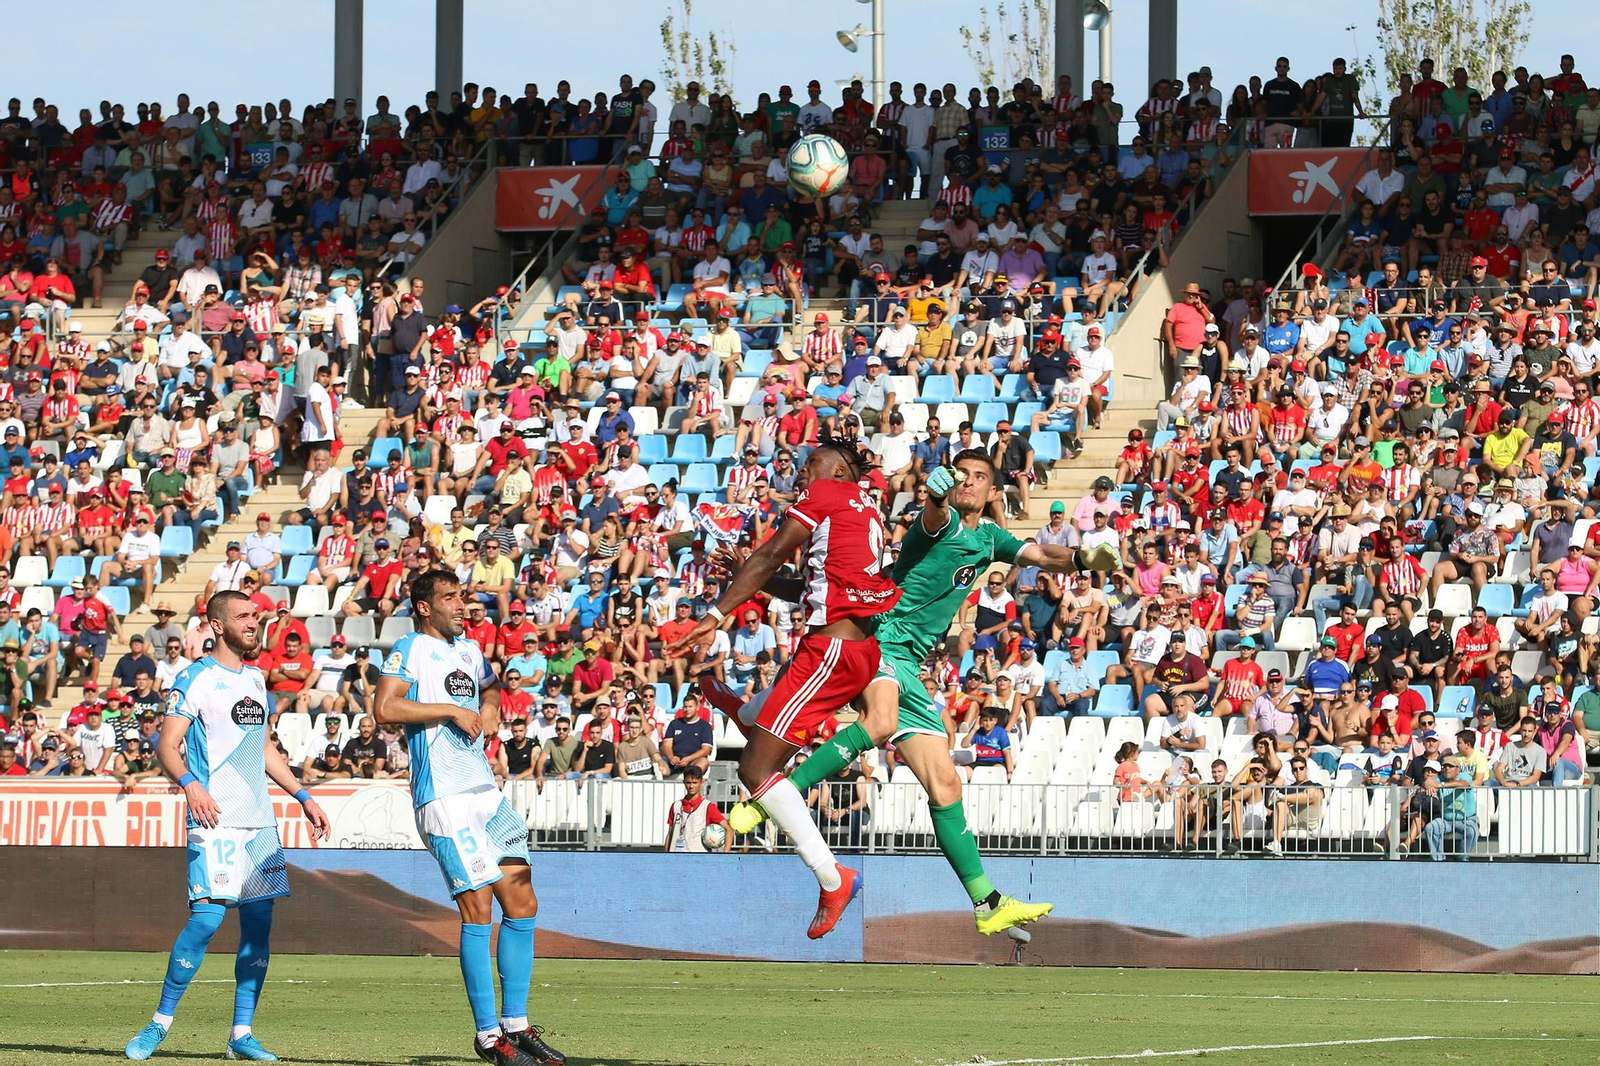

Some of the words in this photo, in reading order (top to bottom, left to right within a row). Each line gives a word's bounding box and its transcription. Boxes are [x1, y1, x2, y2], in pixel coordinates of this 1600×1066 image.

[984, 136, 1007, 148] 132
[251, 152, 271, 164] 133
[1465, 643, 1489, 652] adidas
[449, 676, 473, 688] Estrella
[236, 705, 262, 714] Estrella
[238, 714, 262, 724] Galicia
[457, 826, 478, 854] 5
[213, 838, 236, 866] 12
